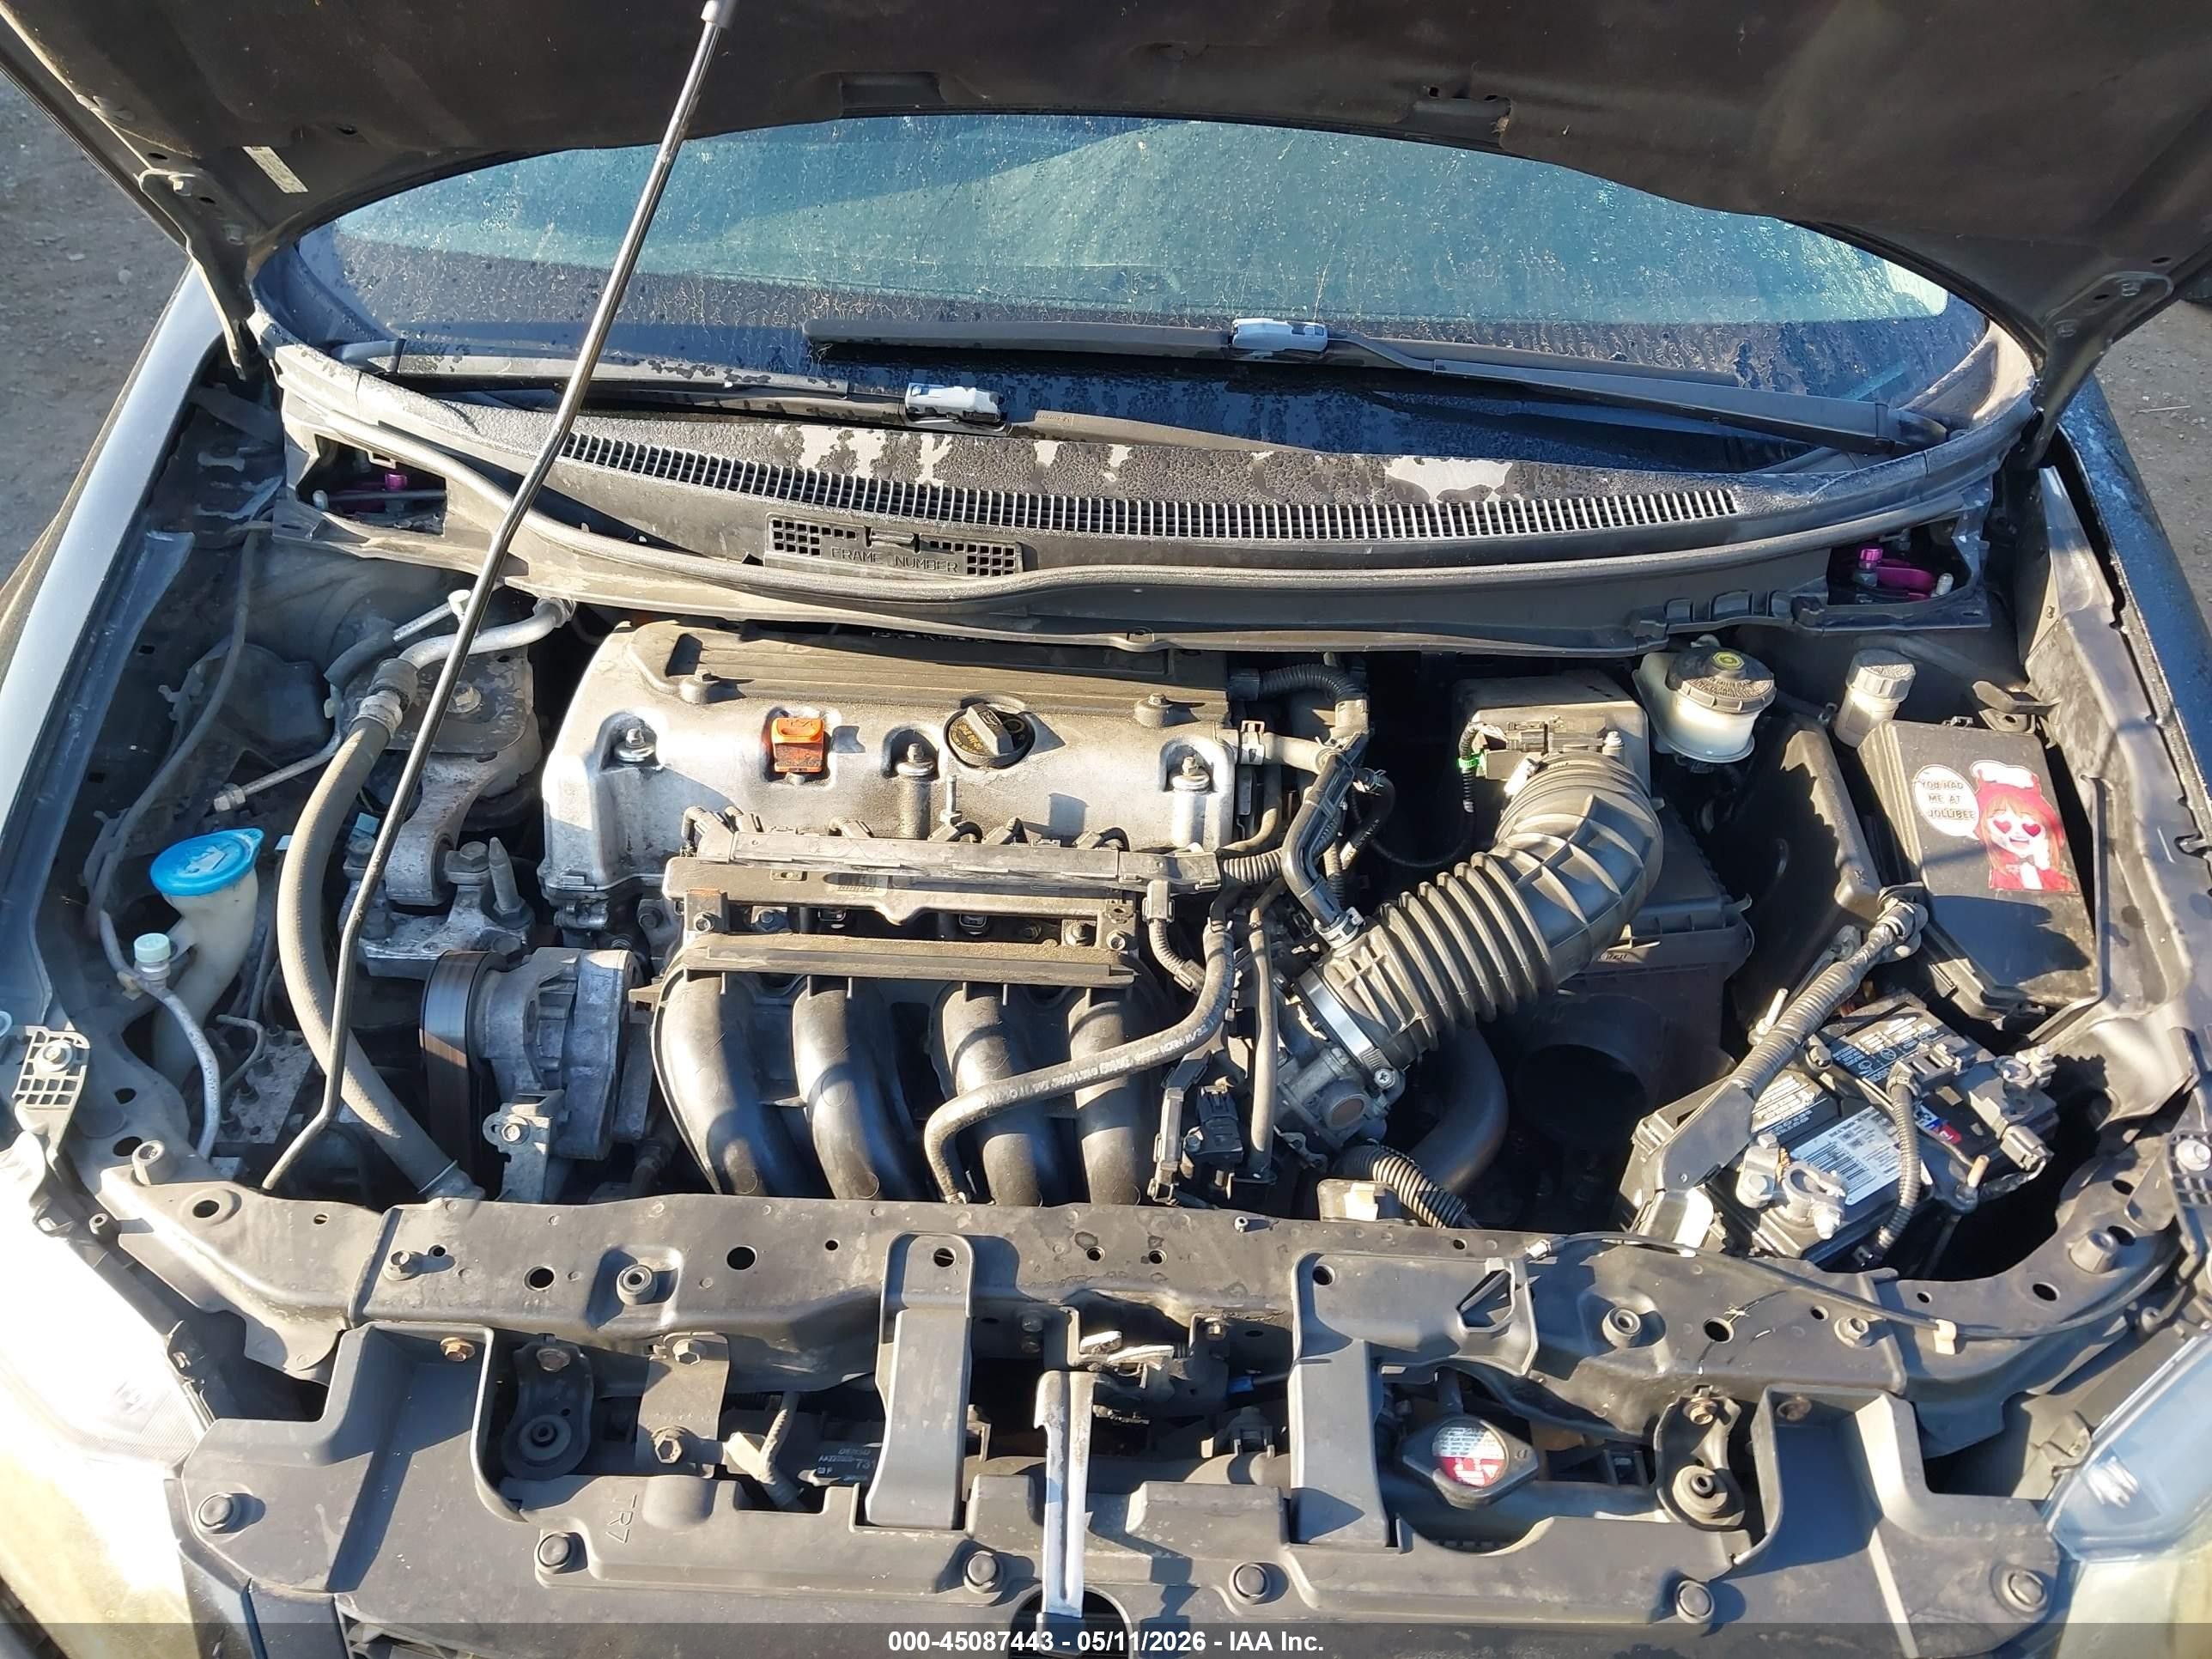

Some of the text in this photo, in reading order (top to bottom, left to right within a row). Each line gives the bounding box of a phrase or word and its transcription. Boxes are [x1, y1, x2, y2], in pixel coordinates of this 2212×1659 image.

[830, 547, 958, 573] FRAME NUMBER
[1921, 780, 1964, 790] YOU HAD
[1929, 794, 1961, 805] ME AT
[1929, 809, 1976, 819] JOLLIBEE
